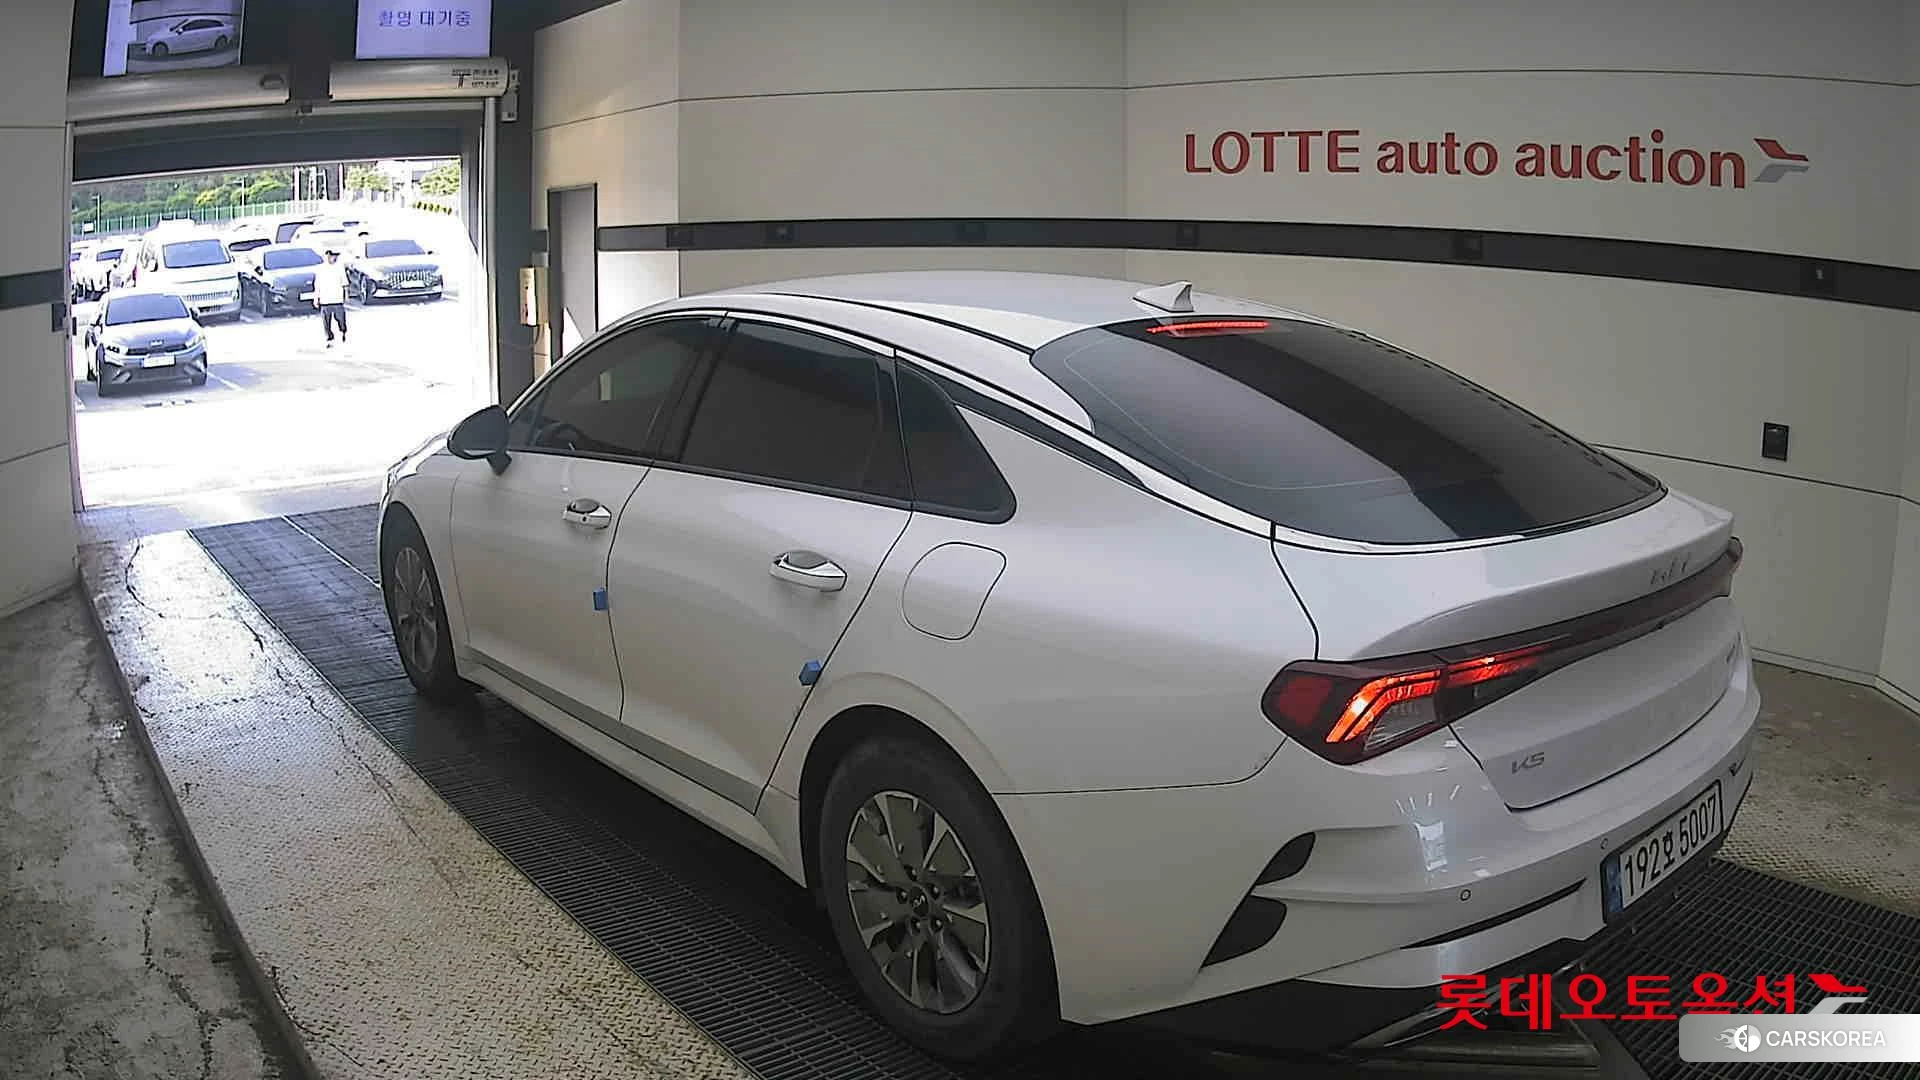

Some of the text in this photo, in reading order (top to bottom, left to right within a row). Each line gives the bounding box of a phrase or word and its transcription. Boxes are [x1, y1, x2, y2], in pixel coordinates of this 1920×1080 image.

[420, 10, 471, 27] 대기중
[1184, 129, 1746, 189] LOTTE auto auction
[1624, 792, 1717, 897] 192호 5007
